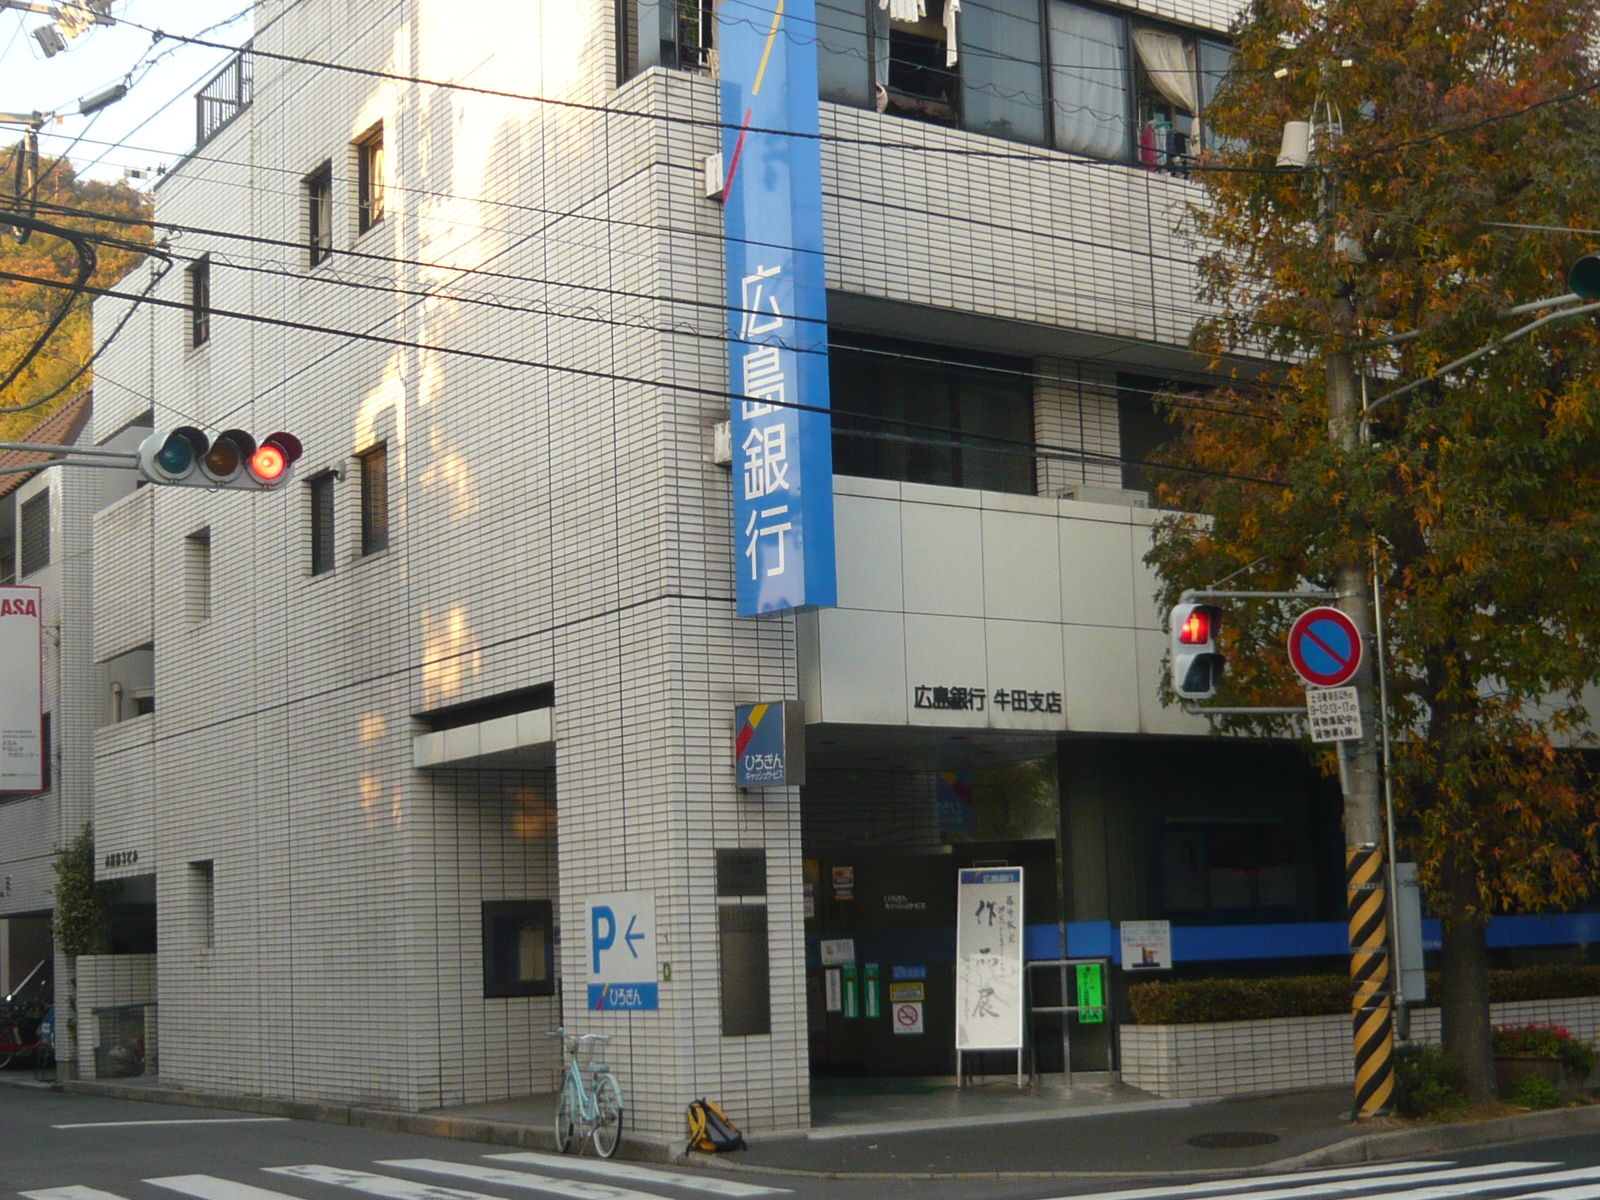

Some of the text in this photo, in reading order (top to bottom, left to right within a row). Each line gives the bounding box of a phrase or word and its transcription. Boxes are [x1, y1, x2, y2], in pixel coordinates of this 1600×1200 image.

[740, 265, 792, 580] 広島銀行
[1, 598, 37, 618] ASA
[914, 684, 1062, 714] 広島銀行 牛田支店
[744, 752, 784, 771] ひろぎん
[591, 904, 616, 974] P
[609, 987, 642, 1006] ひろぎん
